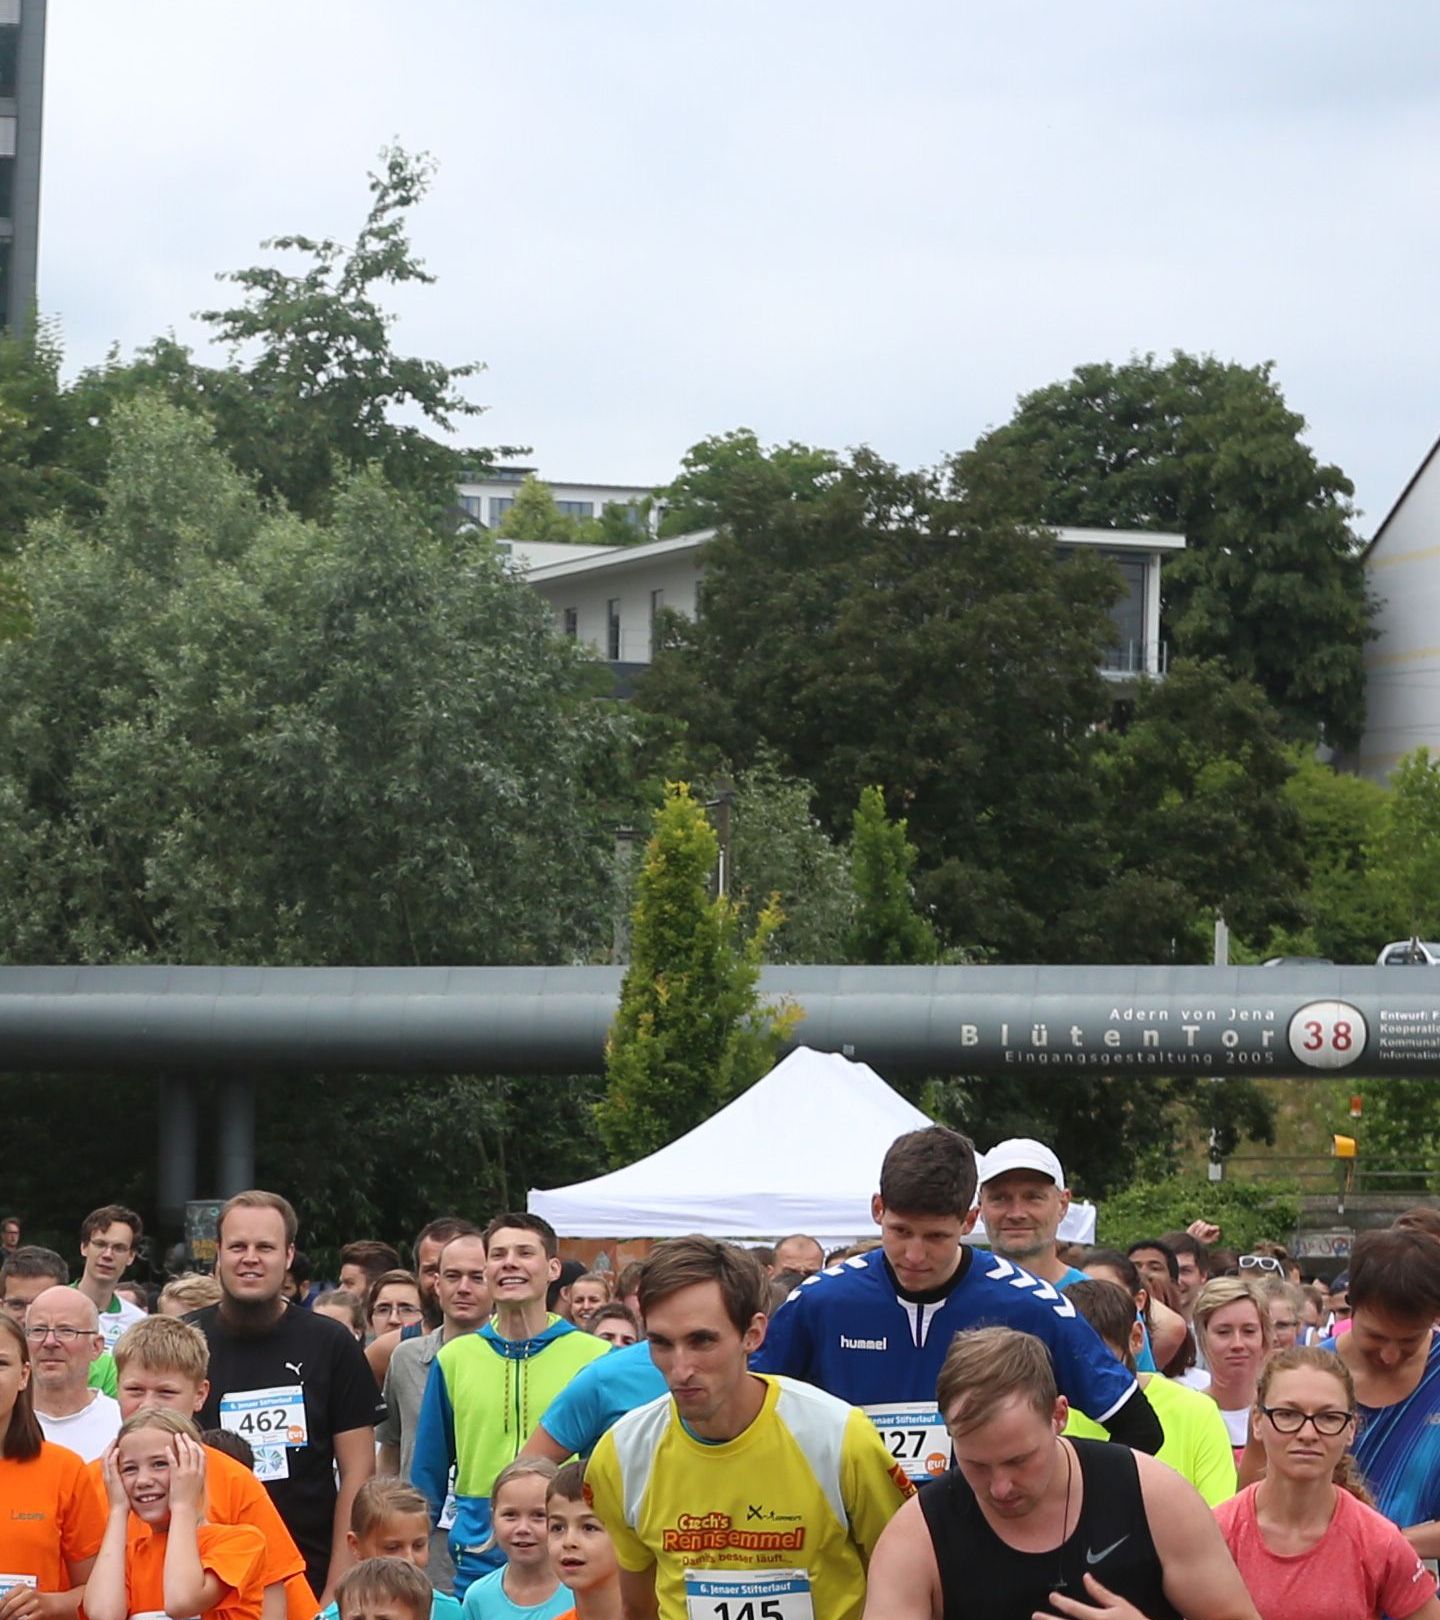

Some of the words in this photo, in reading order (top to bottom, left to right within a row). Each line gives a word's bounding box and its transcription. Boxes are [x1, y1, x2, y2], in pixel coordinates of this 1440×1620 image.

[1110, 1008, 1169, 1021] Adern
[1181, 1011, 1216, 1021] von
[1228, 1009, 1275, 1021] Jena
[1302, 1021, 1353, 1051] 38
[1005, 1050, 1213, 1065] Eingangsgestaltung
[1226, 1051, 1275, 1064] 2005
[840, 1335, 887, 1350] hummel
[239, 1409, 288, 1434] 462
[876, 1416, 894, 1425] enaer
[896, 1415, 936, 1425] Stifterlauf
[927, 1459, 945, 1470] gut
[679, 1513, 729, 1530] Czech's
[664, 1529, 805, 1550] Rennsemmel
[720, 1554, 753, 1565] besser
[700, 1583, 709, 1593] 6.
[710, 1584, 739, 1596] Jenaer
[741, 1582, 791, 1594] Stifterlauf
